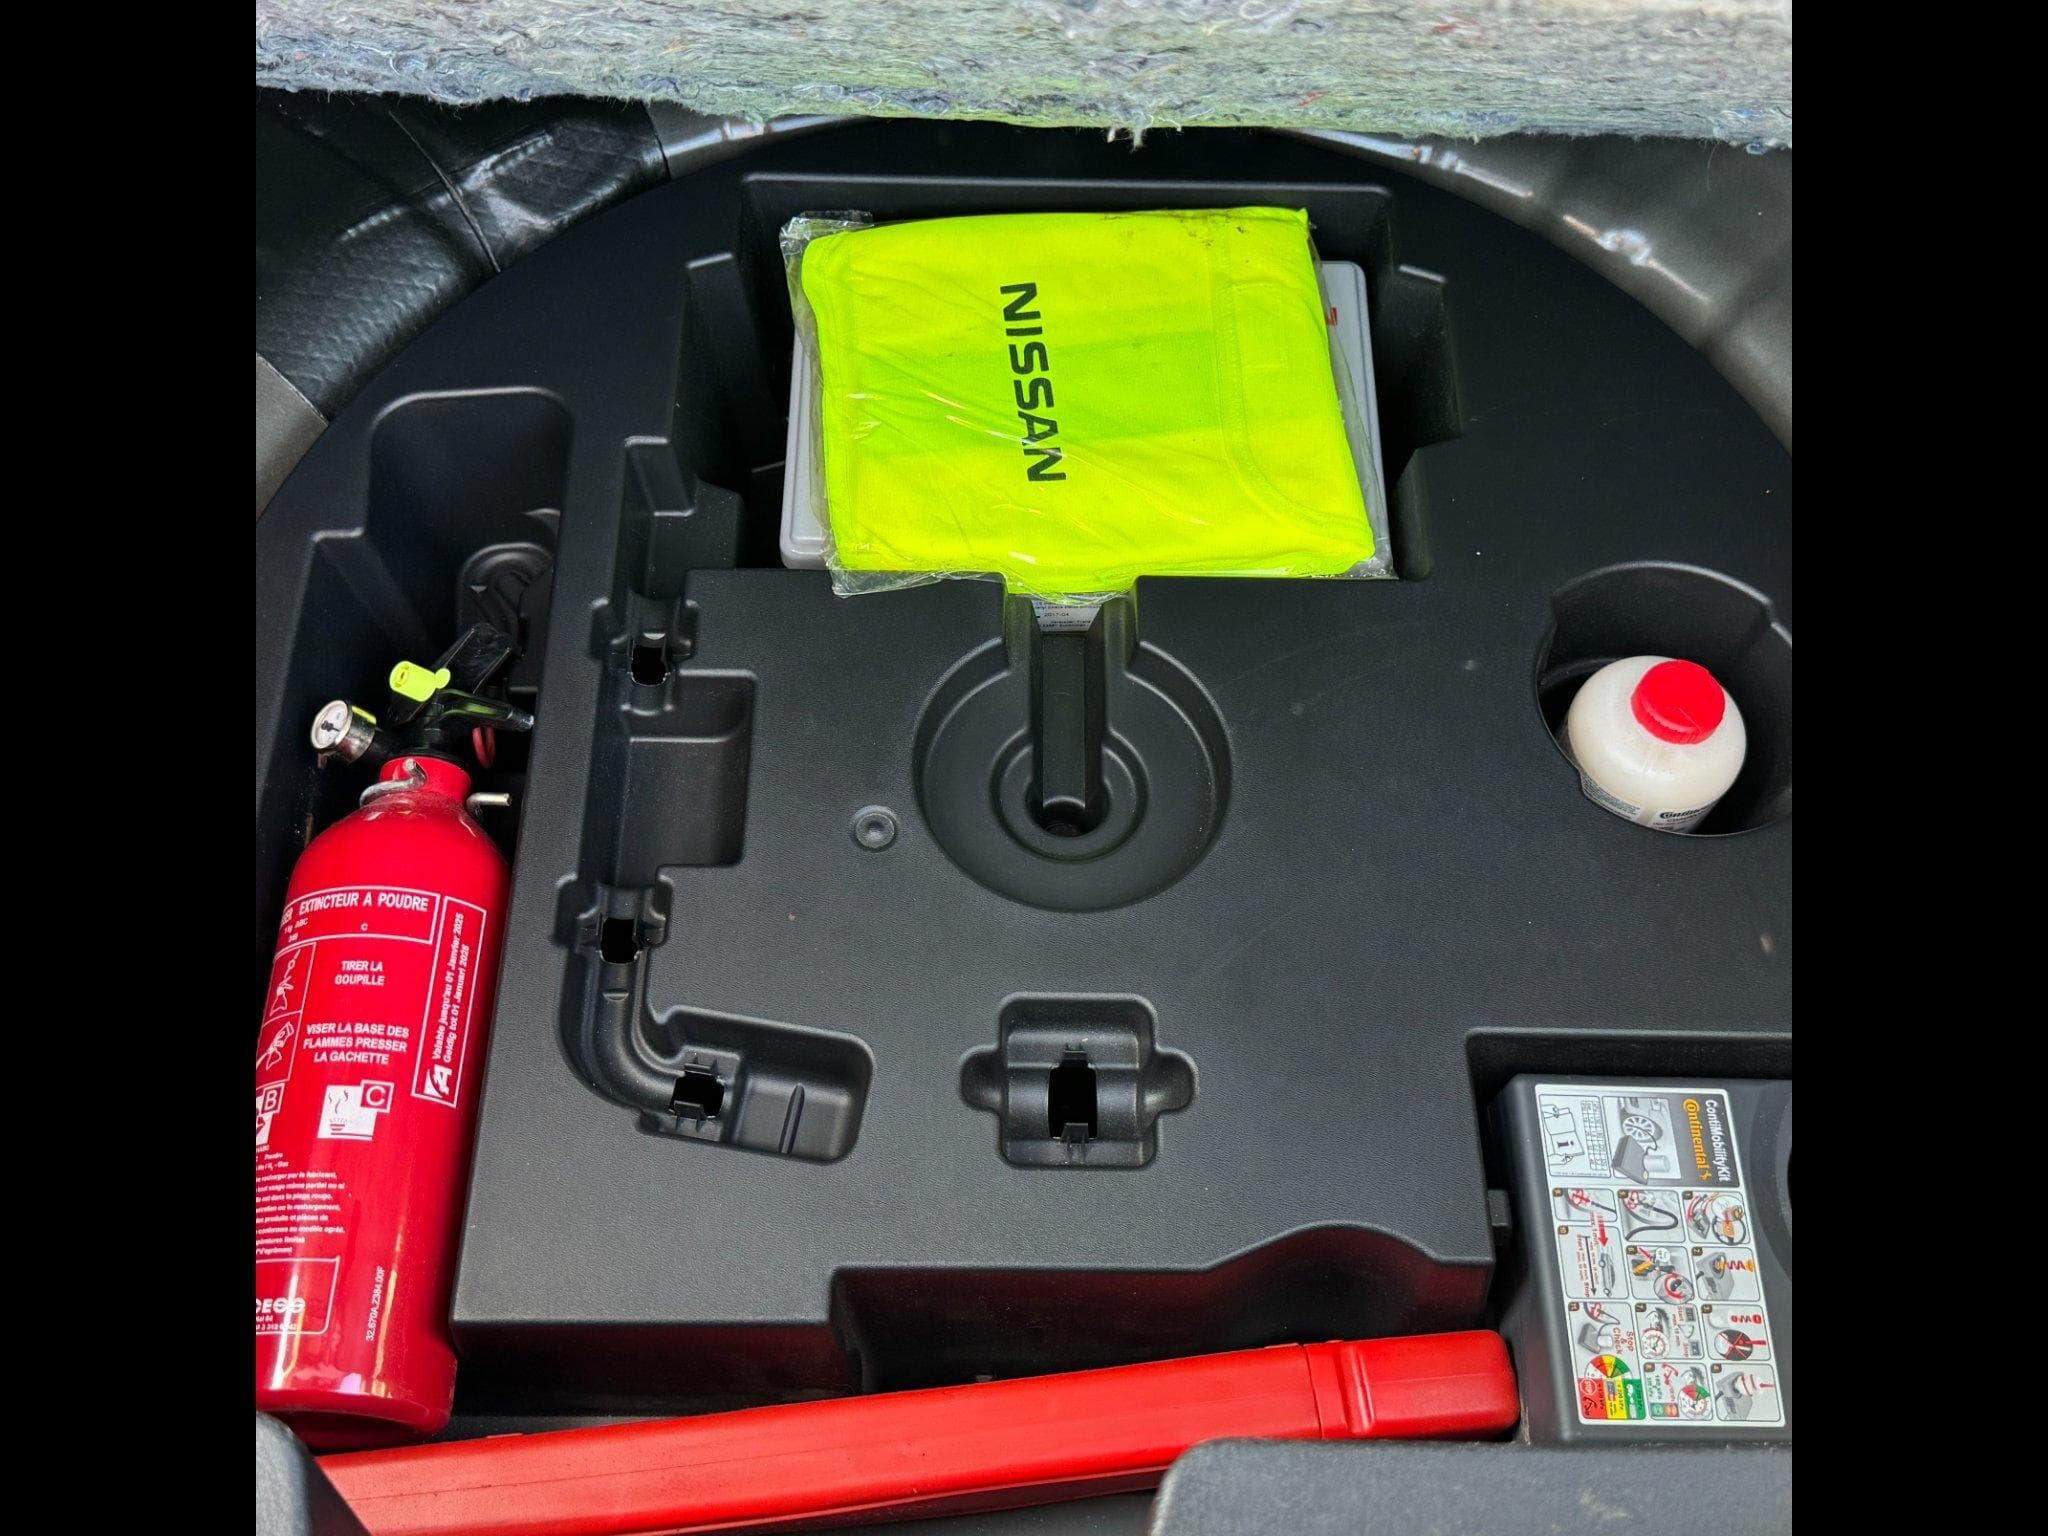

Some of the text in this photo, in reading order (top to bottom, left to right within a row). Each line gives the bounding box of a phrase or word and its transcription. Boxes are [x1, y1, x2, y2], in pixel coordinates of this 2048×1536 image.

[1000, 282, 1067, 482] NISSAN
[299, 893, 359, 915] EXTINCTEUR
[378, 893, 429, 911] POUDRE
[453, 912, 464, 937] 2025
[447, 935, 460, 970] Janvier
[341, 960, 383, 972] TIRER LA
[335, 974, 385, 985] GOUPILLE
[445, 971, 454, 983] 01
[454, 967, 466, 1003] Januari
[451, 1003, 460, 1015] 01
[306, 1022, 409, 1037] VISER LA BASE DES
[303, 1037, 407, 1052] FLAMMES PRESSER
[443, 1032, 457, 1063] Geldig
[313, 1051, 389, 1064] LA GACHETTE
[264, 1090, 278, 1110] B
[366, 1086, 386, 1106] C
[1683, 1098, 1709, 1170] Continental
[1705, 1099, 1731, 1182] ContiMobilityKit
[1613, 1327, 1622, 1356] Check
